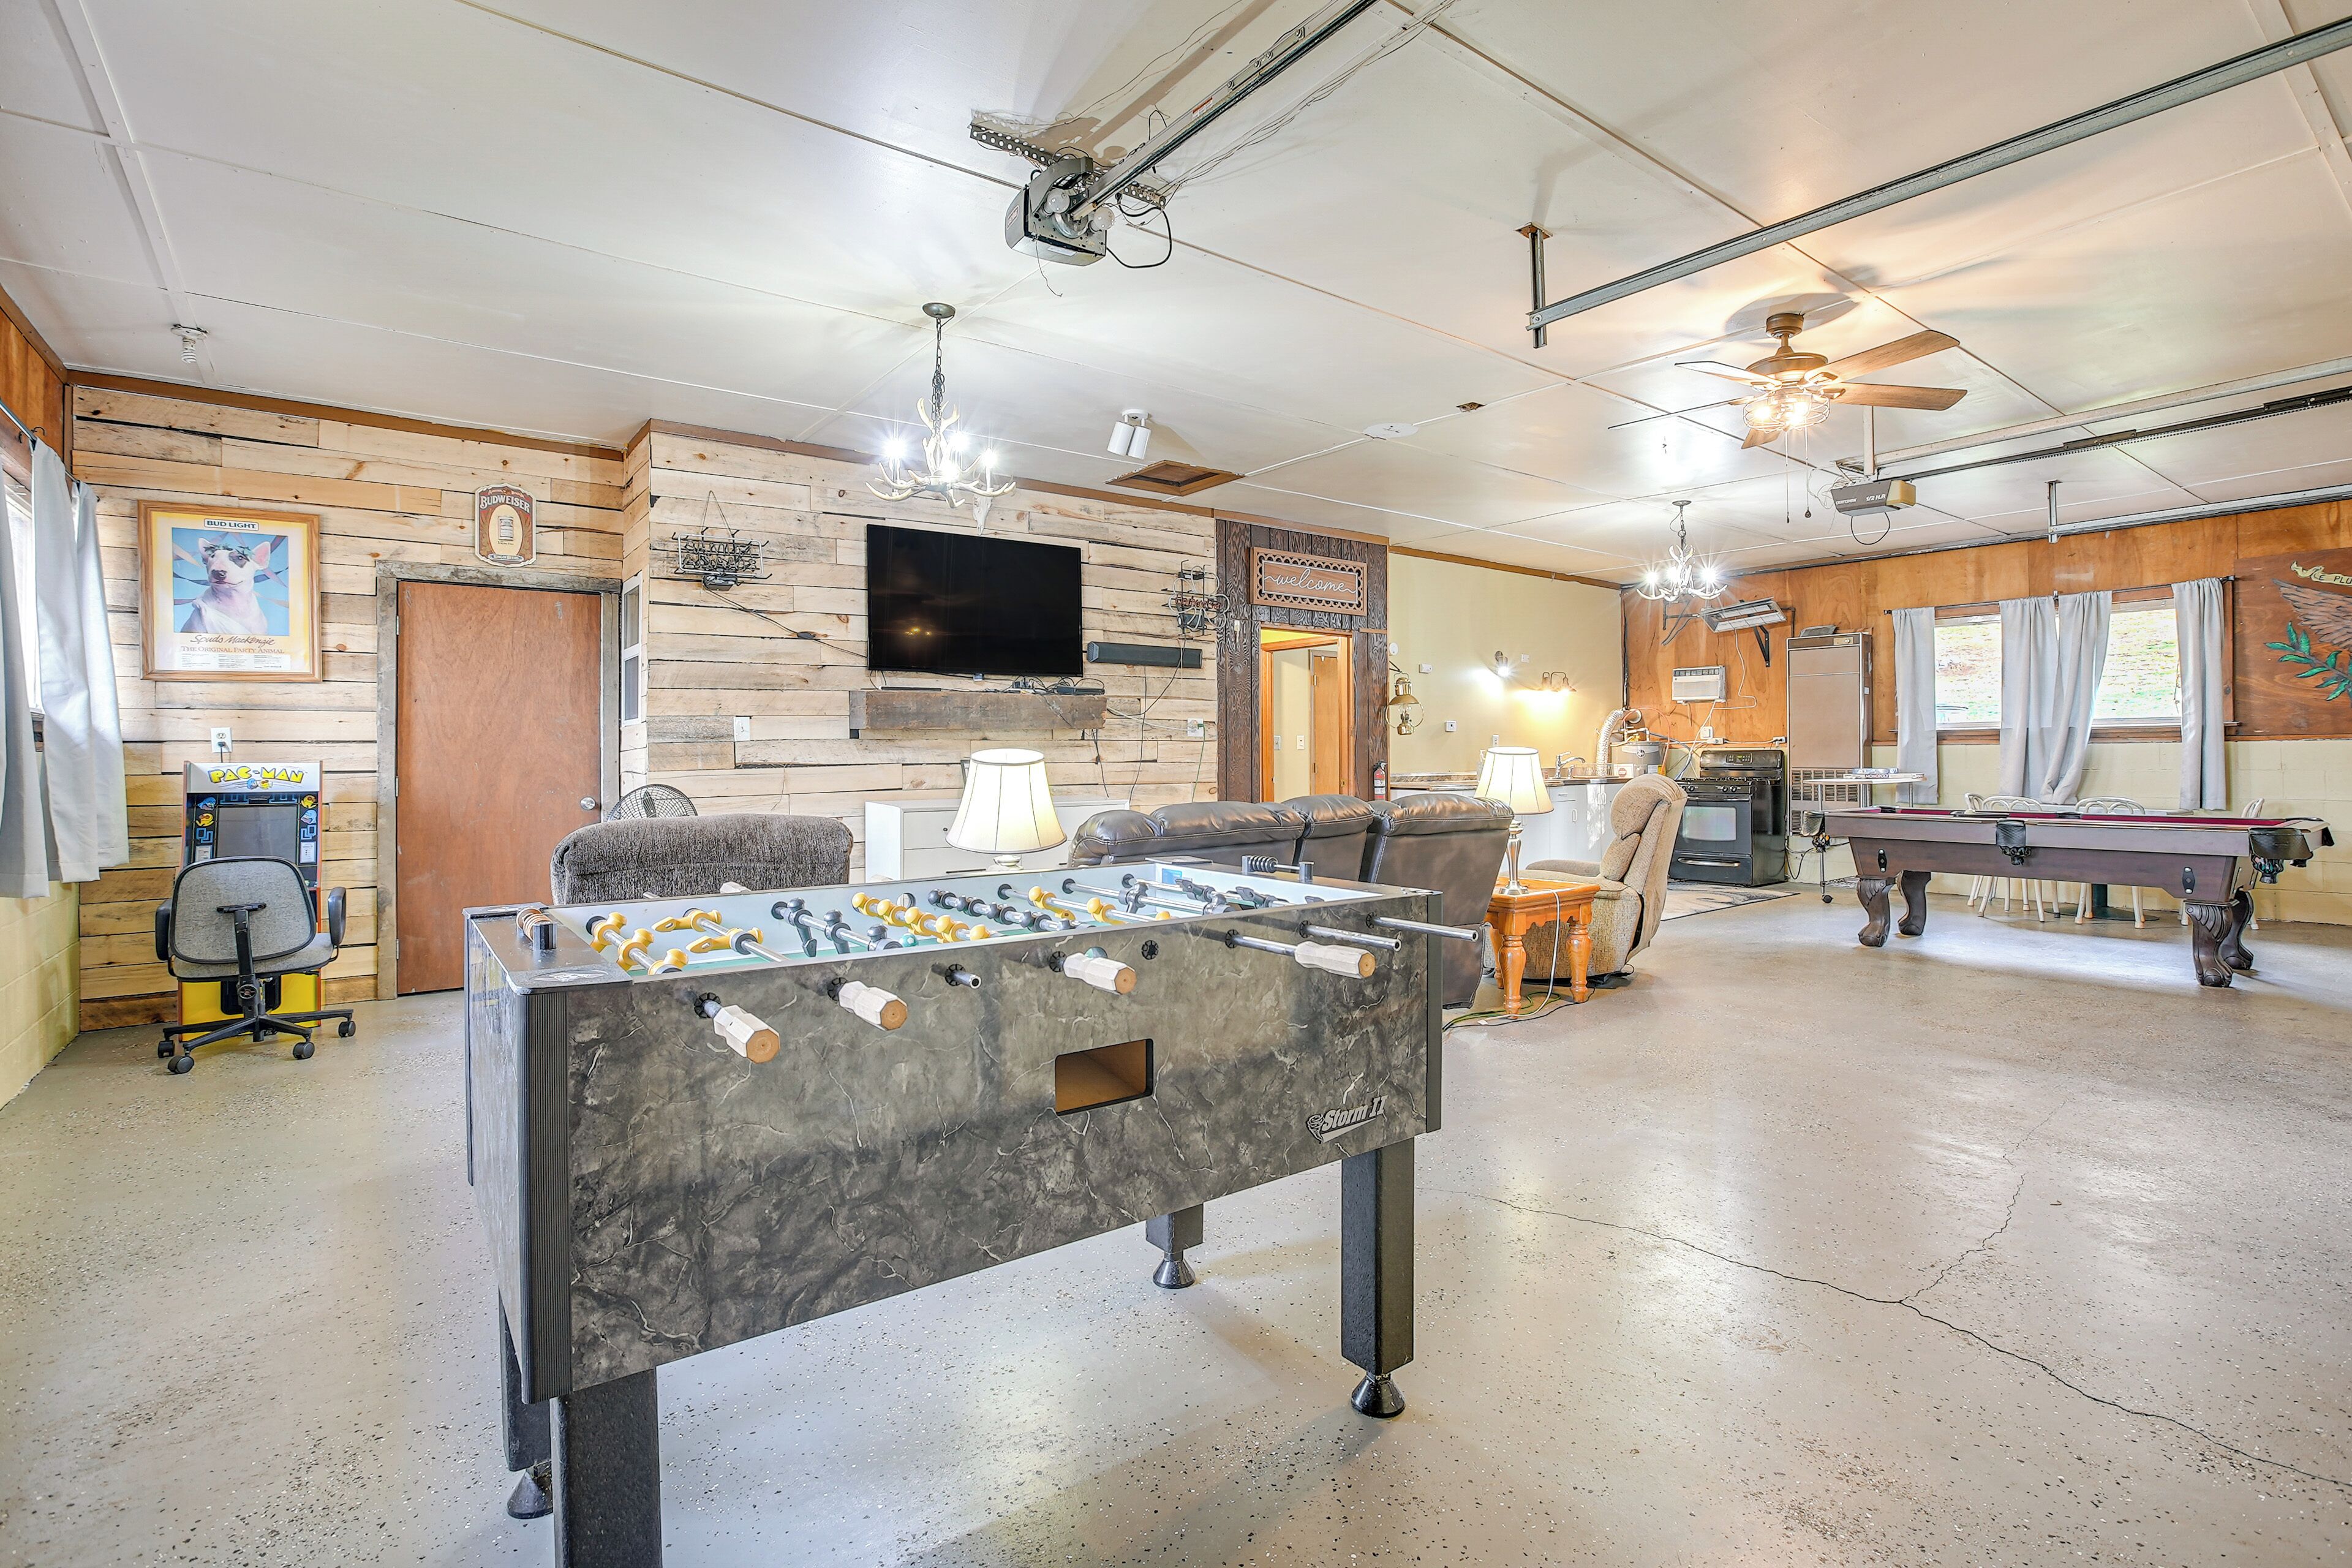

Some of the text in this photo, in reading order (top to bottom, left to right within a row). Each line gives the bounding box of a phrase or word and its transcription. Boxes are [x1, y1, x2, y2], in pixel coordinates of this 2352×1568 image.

[480, 494, 530, 513] BUDWEISER
[1265, 568, 1356, 594] welcome
[190, 635, 224, 644] Spuds
[208, 766, 304, 783] PAC-MAN
[1321, 1095, 1389, 1132] Storm II
